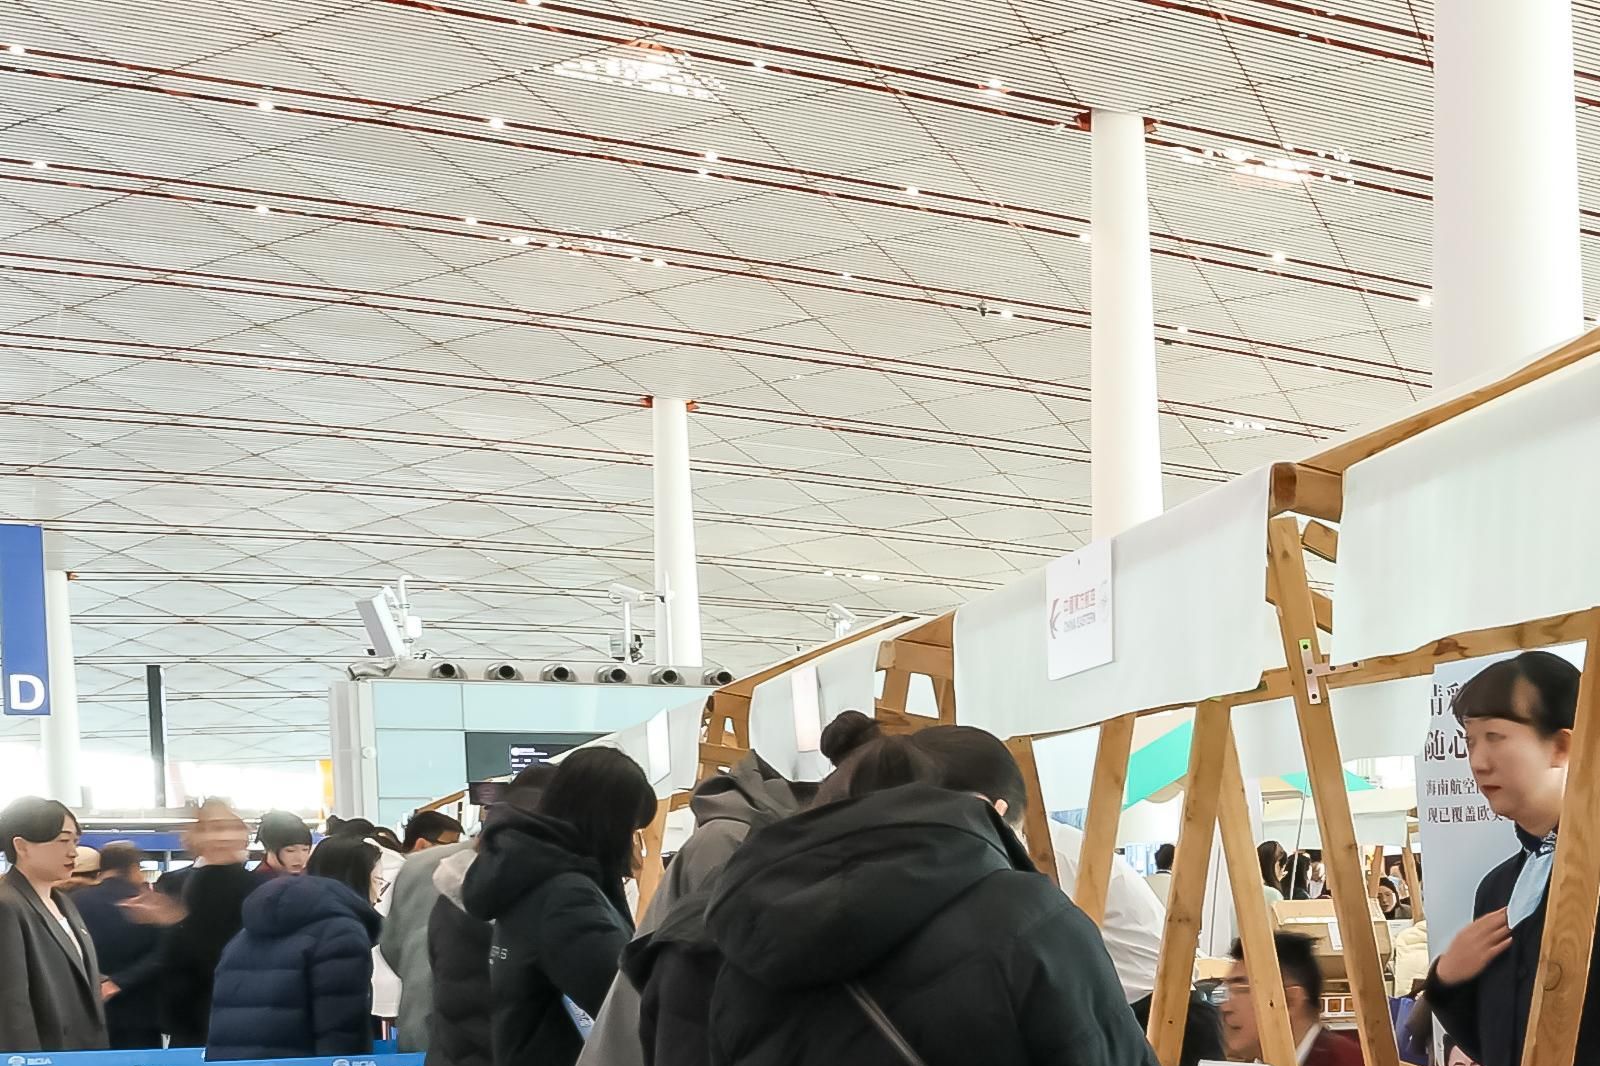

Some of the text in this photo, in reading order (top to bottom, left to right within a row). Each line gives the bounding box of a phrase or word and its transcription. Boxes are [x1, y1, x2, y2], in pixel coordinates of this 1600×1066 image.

[9, 674, 46, 711] D
[1425, 778, 1480, 796] 海南航空
